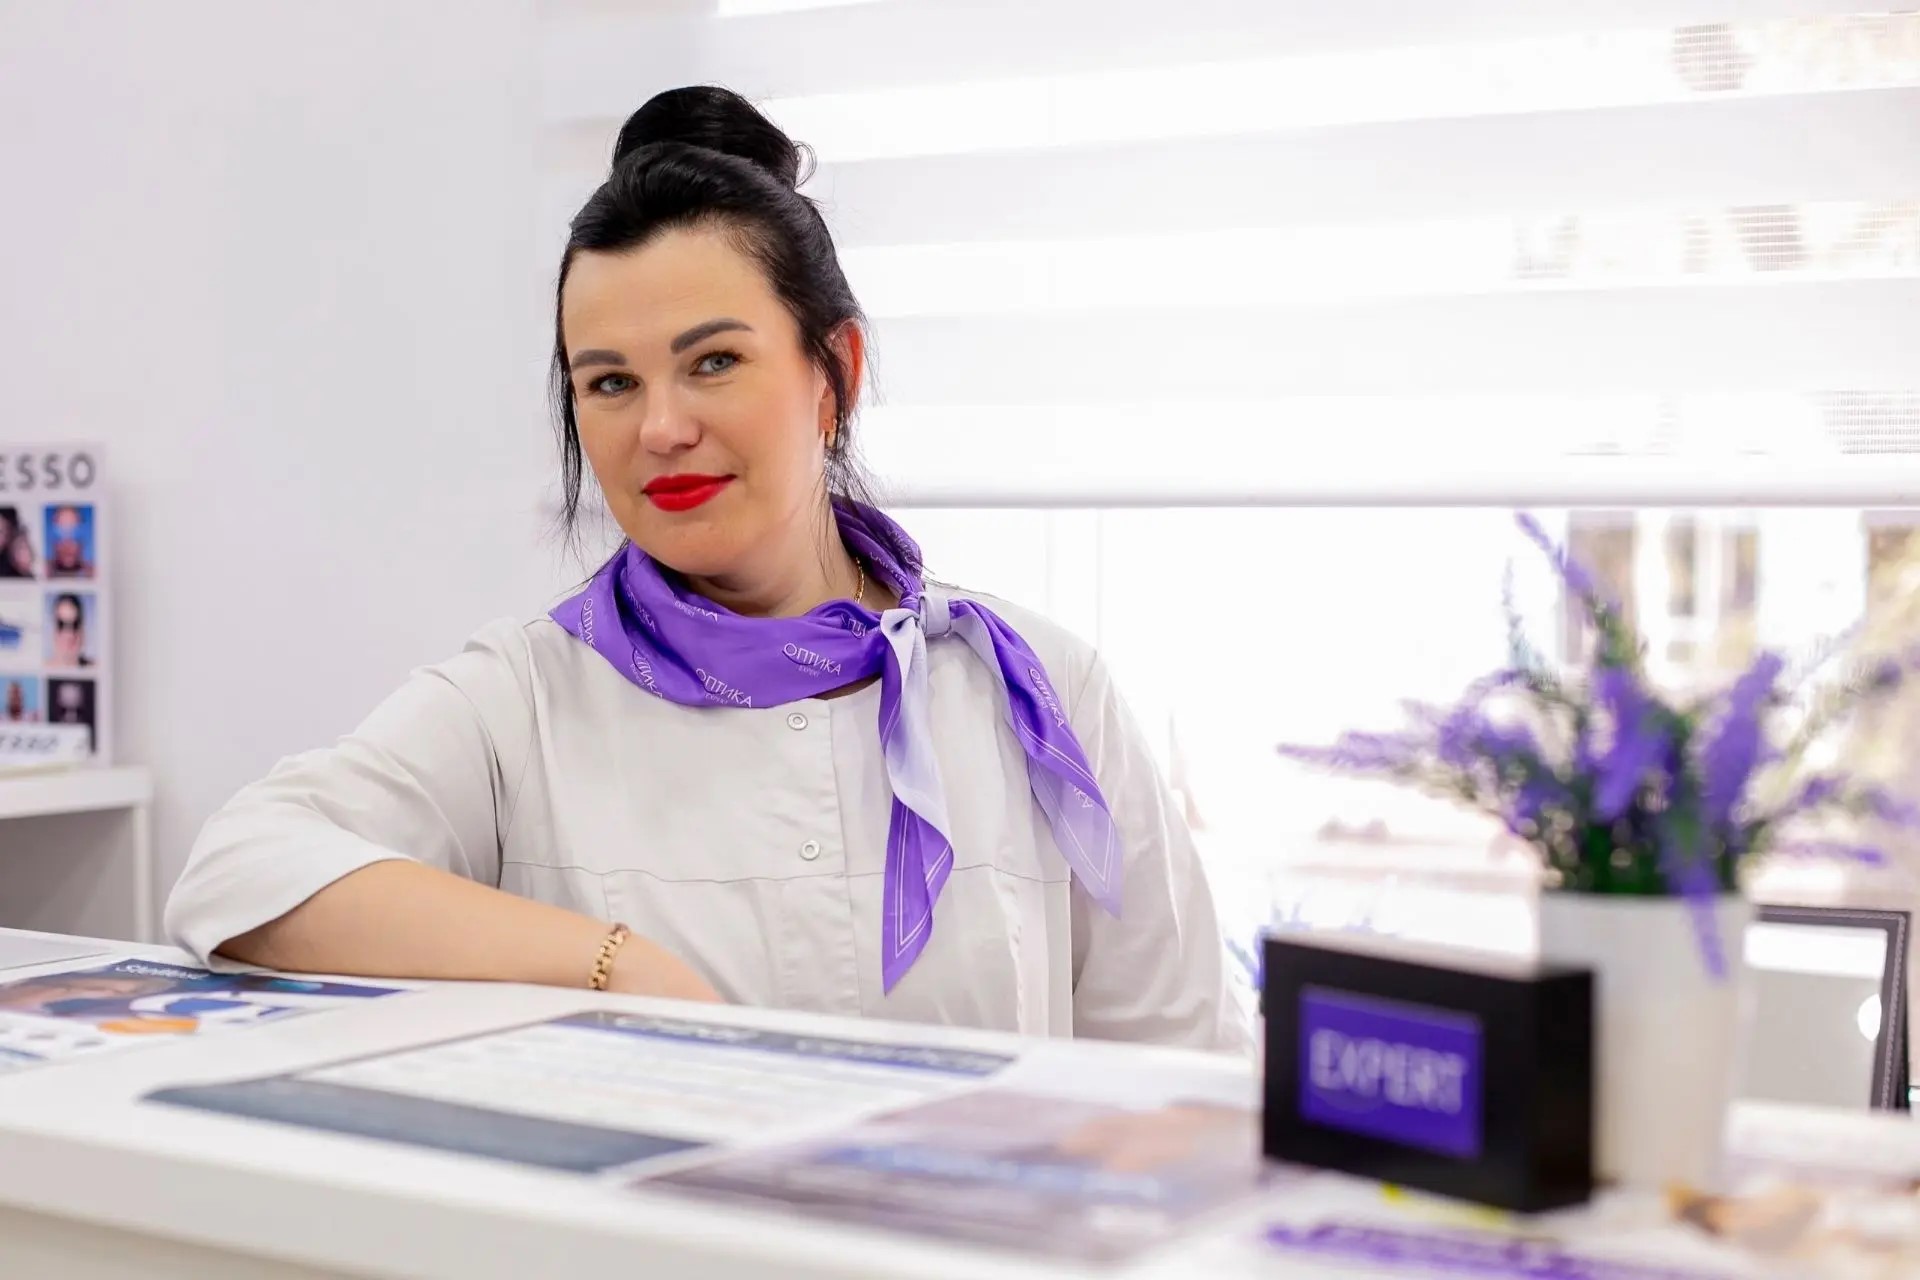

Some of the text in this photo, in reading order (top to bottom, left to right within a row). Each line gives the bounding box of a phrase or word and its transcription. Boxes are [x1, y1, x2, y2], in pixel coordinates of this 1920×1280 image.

[583, 598, 595, 647] ОПТИК
[783, 642, 842, 676] ОПТИКА
[695, 668, 752, 708] ОПТИКА
[1029, 668, 1065, 729] ОПТИКА
[1309, 1028, 1470, 1117] EXPERT
